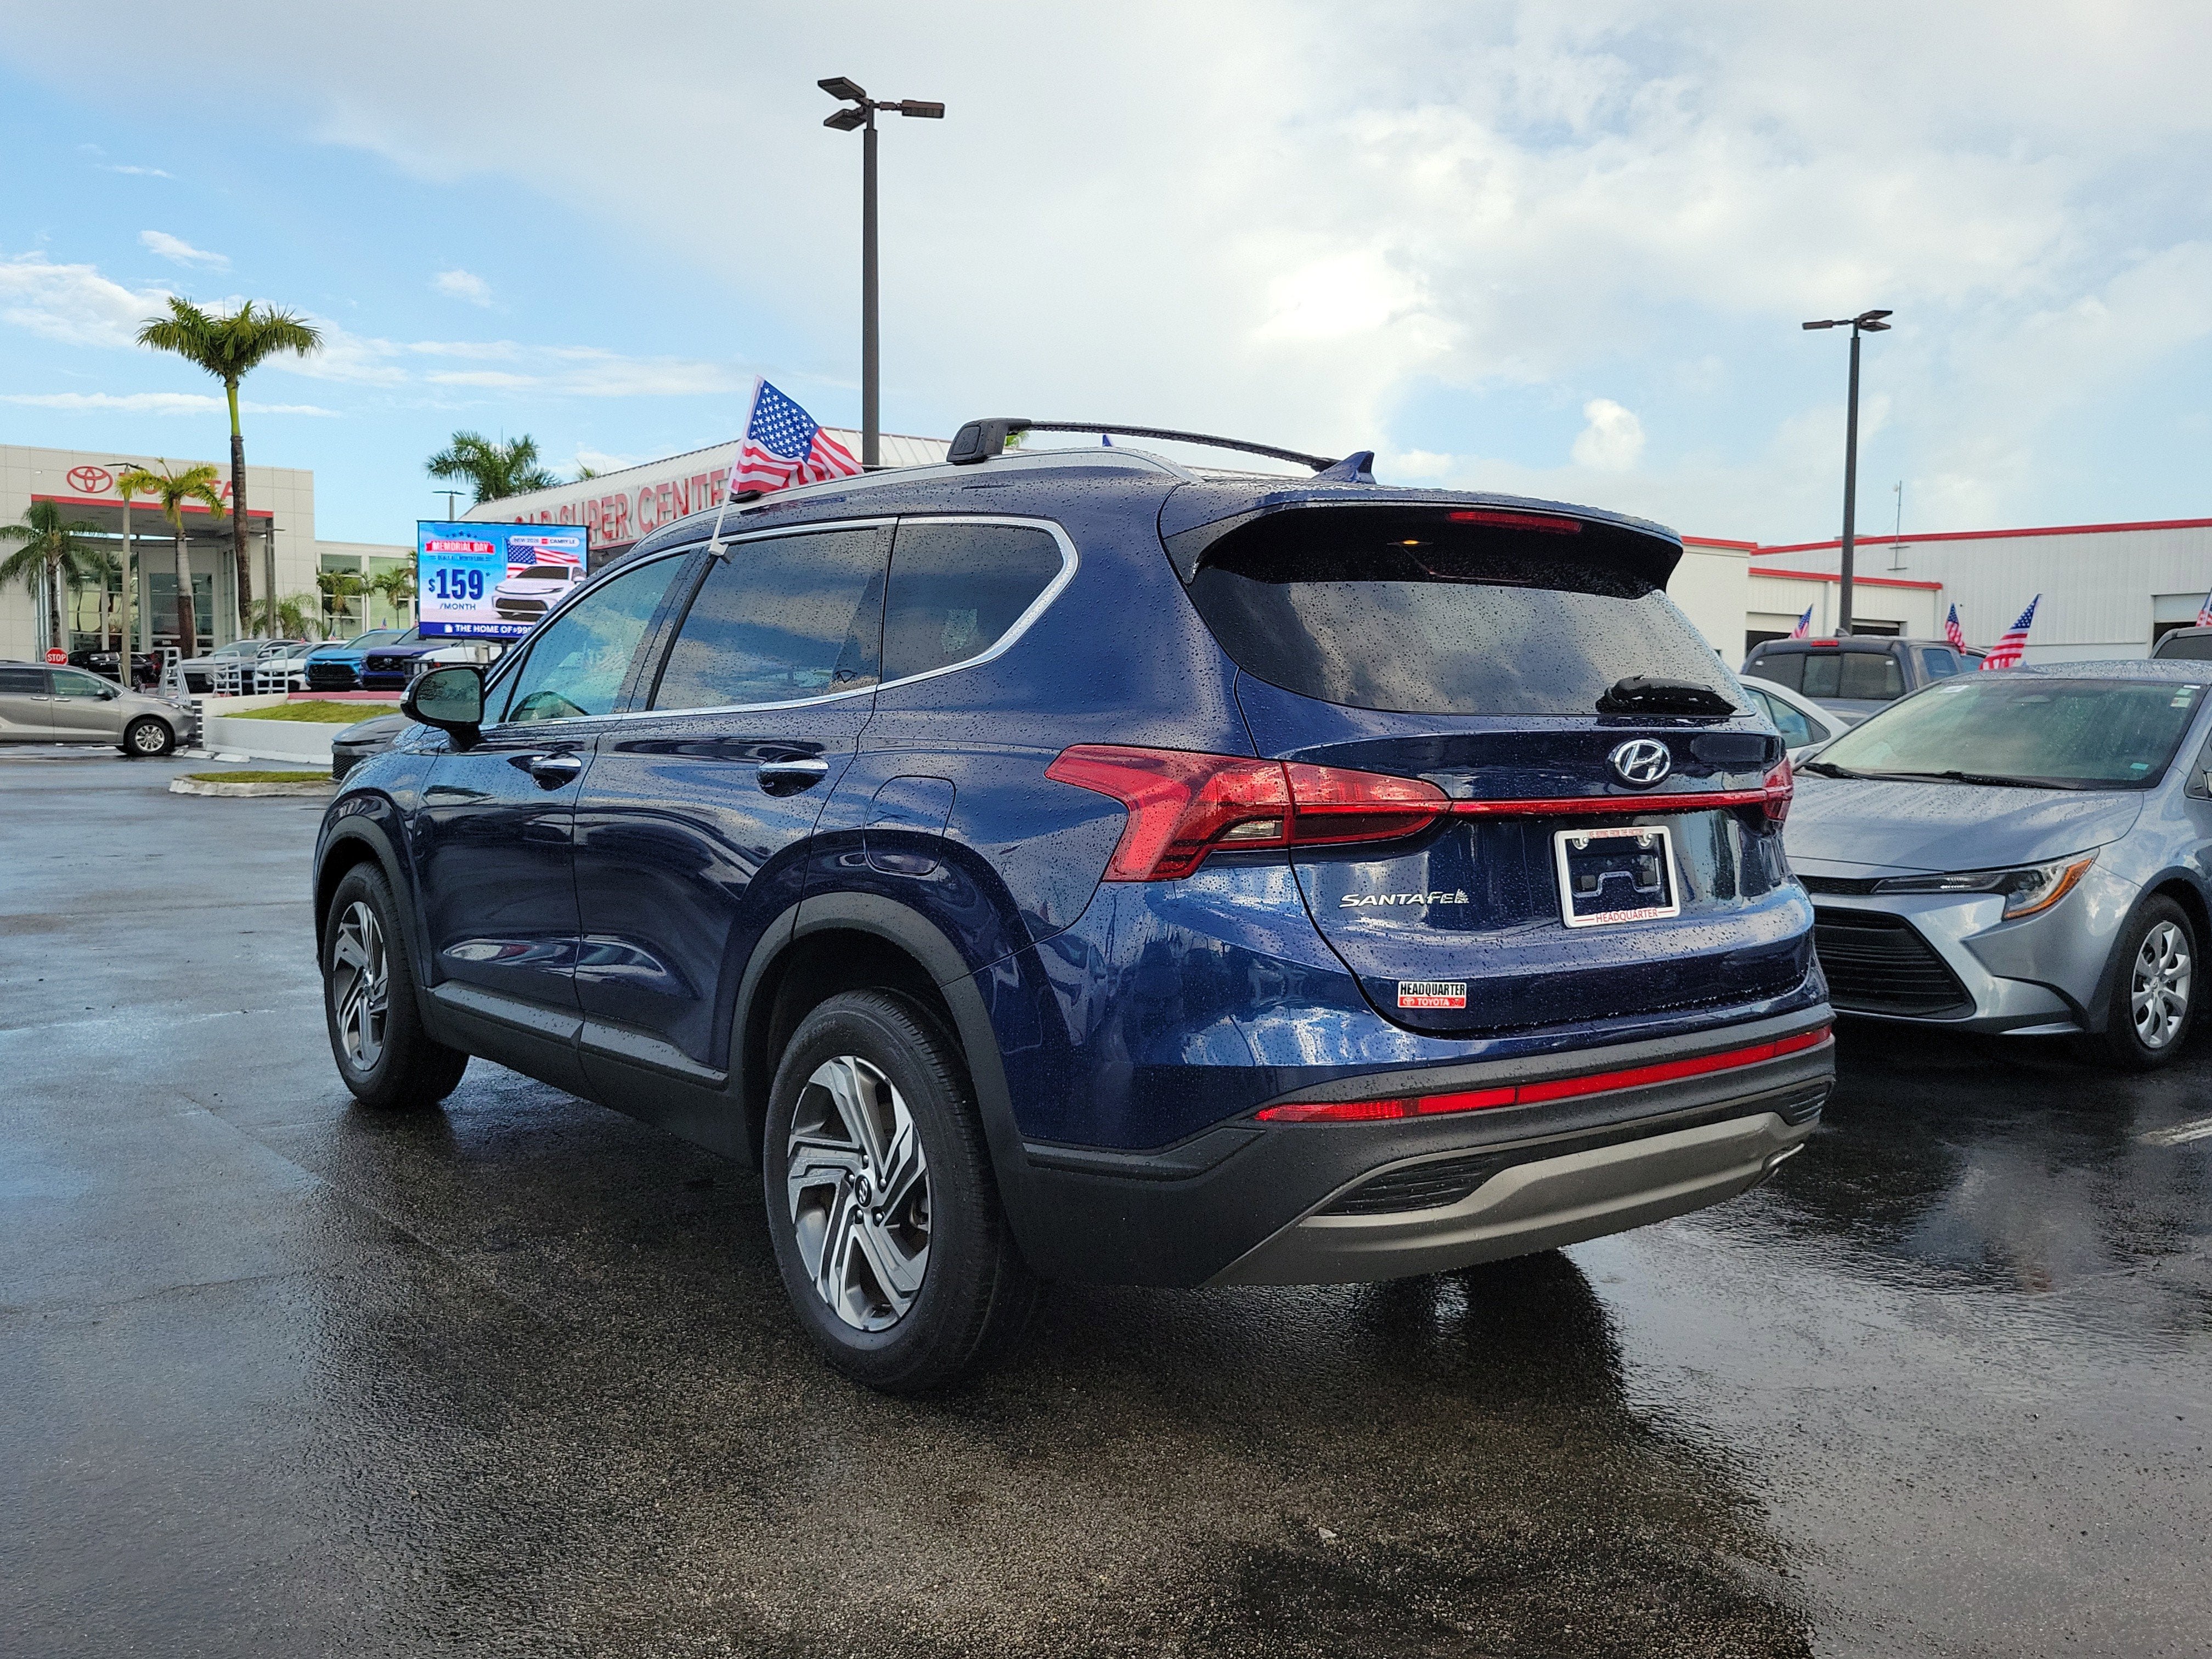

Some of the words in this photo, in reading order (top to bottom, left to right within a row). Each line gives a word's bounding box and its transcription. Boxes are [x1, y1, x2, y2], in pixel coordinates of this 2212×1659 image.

[638, 467, 733, 534] CENTE
[431, 541, 471, 552] MEMORIAL
[473, 543, 489, 552] DAY
[455, 624, 472, 632] THE
[473, 624, 499, 634] HOME
[500, 625, 513, 634] OF
[47, 653, 66, 662] STOP
[1596, 909, 1658, 923] HEADQUARTER
[1400, 983, 1465, 996] HEADQUARTER
[1417, 998, 1449, 1006] TOYOTA
